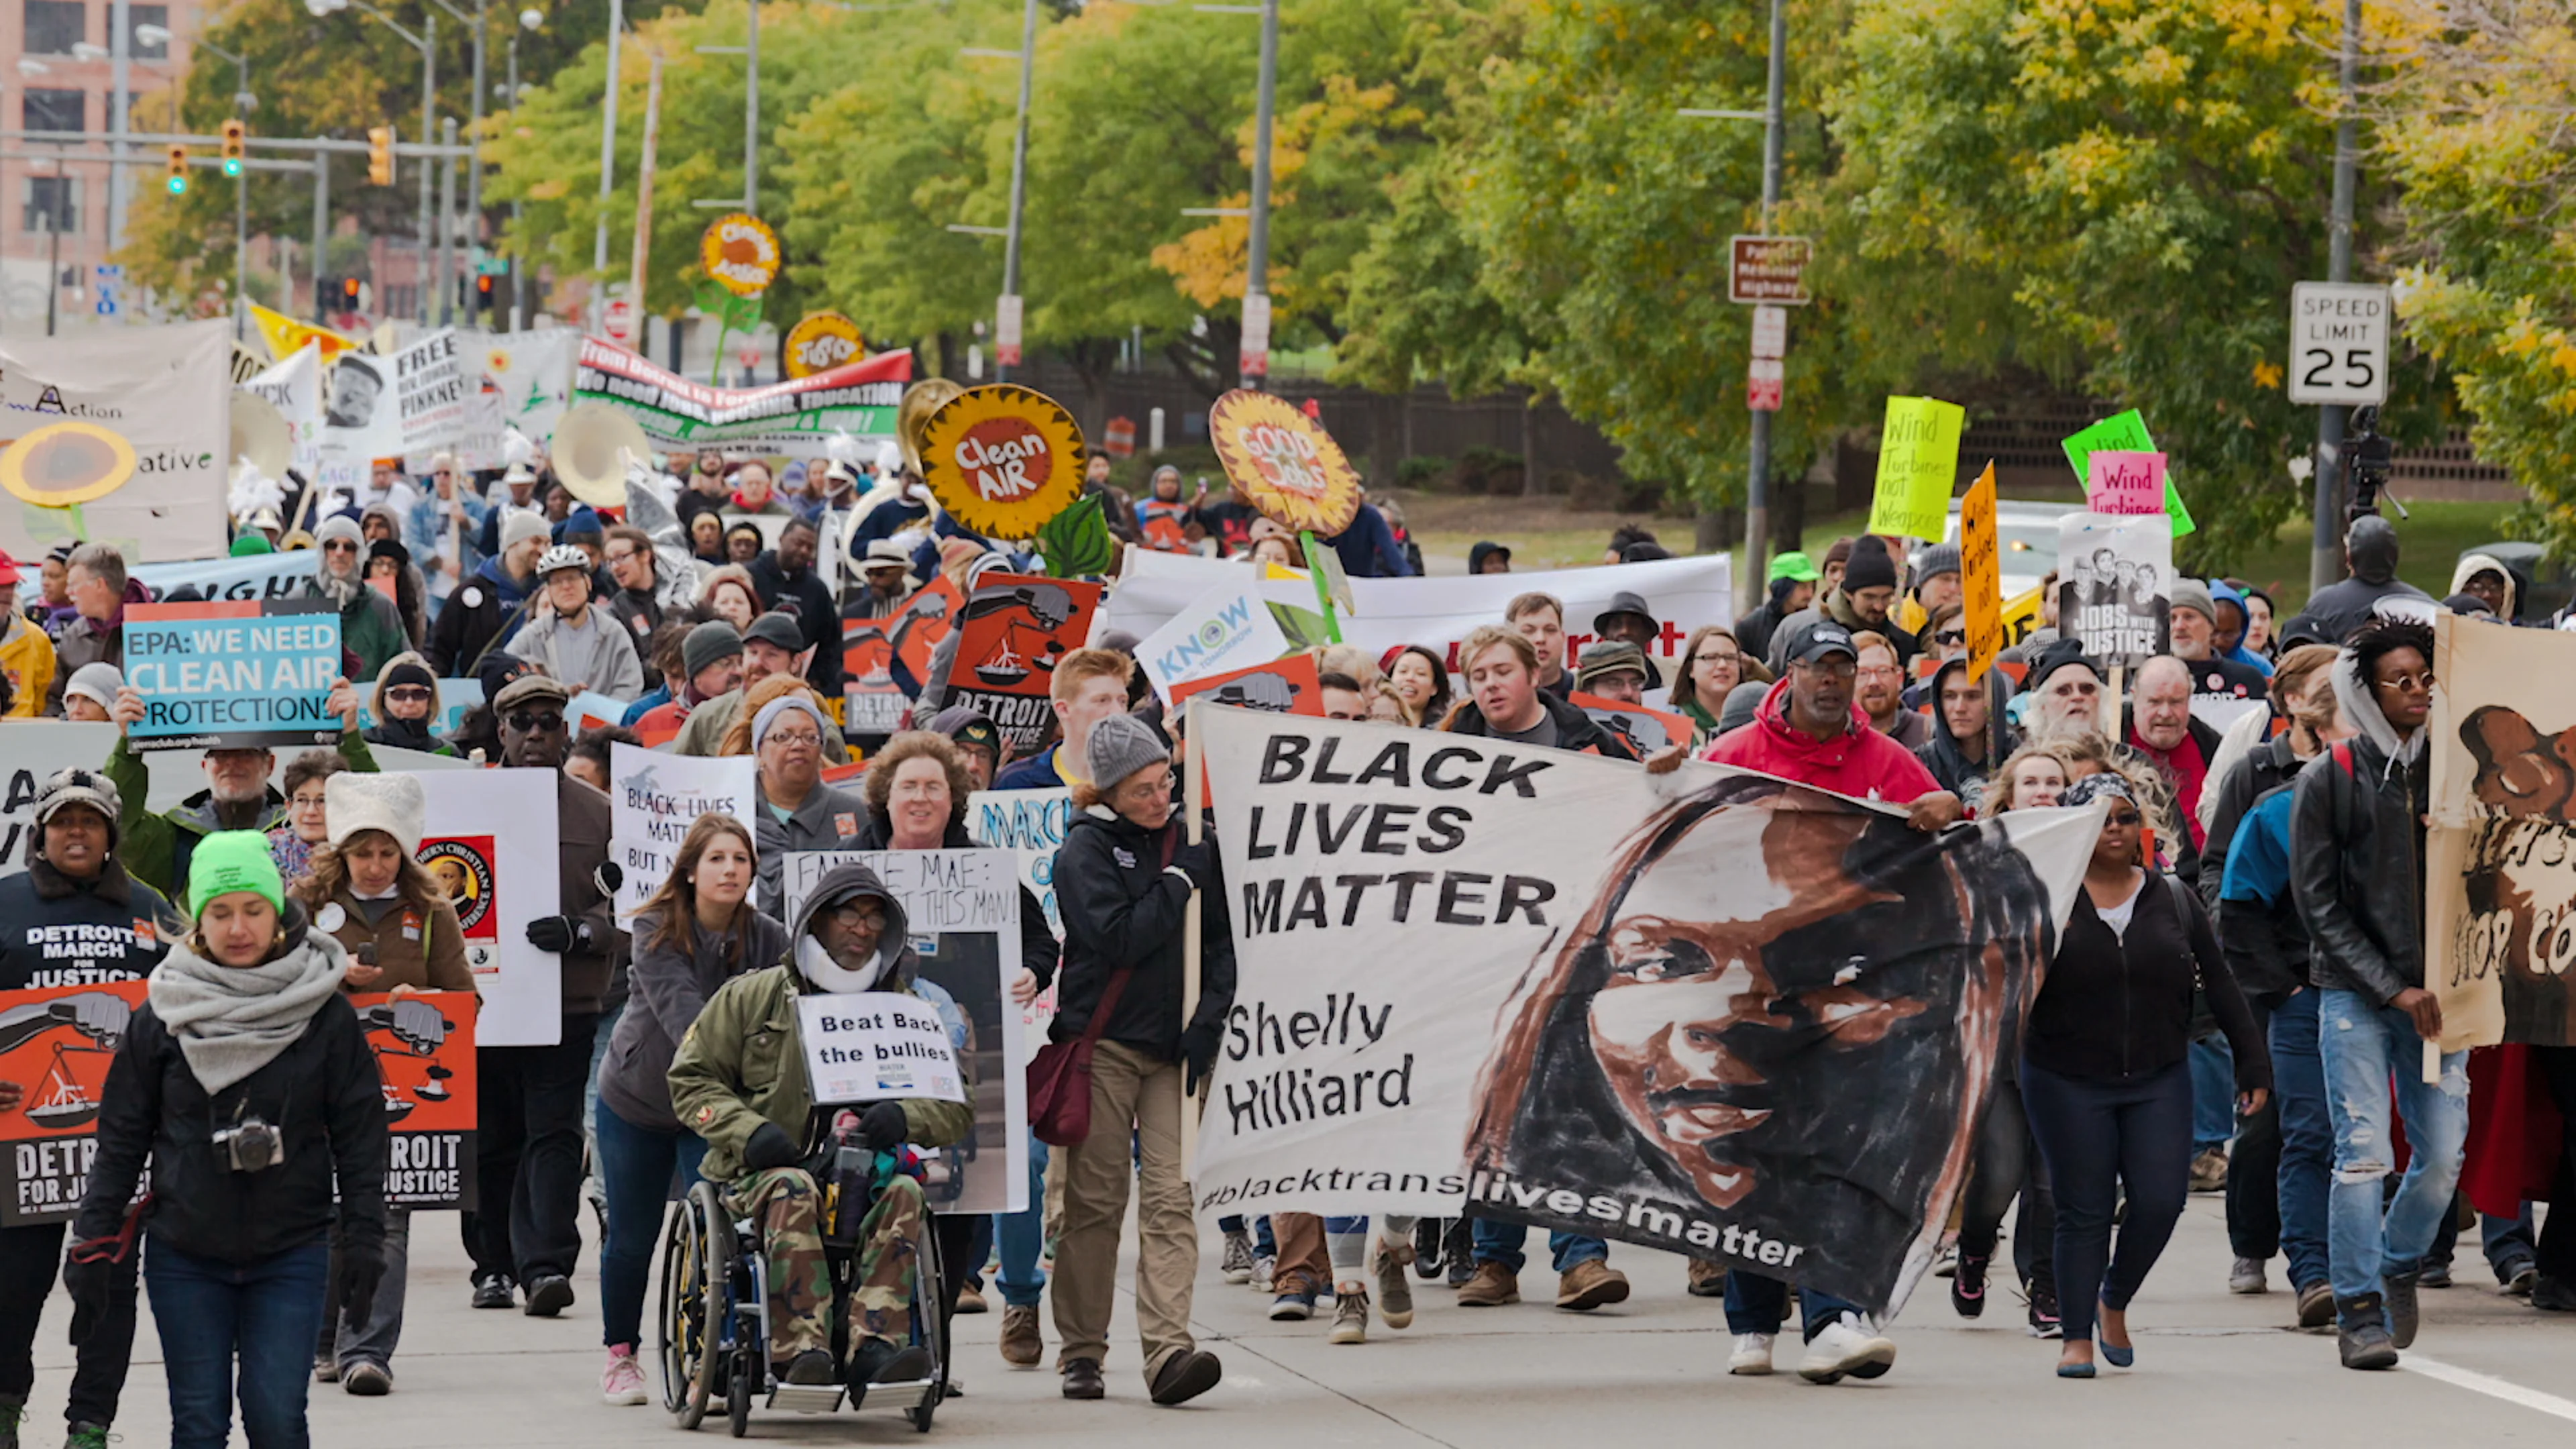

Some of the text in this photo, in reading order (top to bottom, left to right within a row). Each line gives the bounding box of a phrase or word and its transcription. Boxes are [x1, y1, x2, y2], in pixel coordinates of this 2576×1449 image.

[2304, 298, 2380, 317] SPEED
[2310, 324, 2369, 340] LIMIT
[396, 336, 458, 377] FREE
[2304, 347, 2374, 388] 25
[36, 384, 123, 419] Action
[400, 373, 464, 419] PINKNEY
[800, 382, 903, 411] EDUCATION
[1238, 425, 1317, 460] GOOD
[1888, 410, 1939, 443] Wind
[955, 434, 1046, 470] Clean
[1883, 445, 1949, 477] Turbines
[977, 462, 1036, 502] AIR
[1881, 476, 1908, 497] not
[2102, 462, 2153, 490] Wind
[1878, 500, 1942, 535] Weapons
[2074, 604, 2156, 631] JOBS WITH
[128, 625, 336, 655] EPA: WE NEED
[1156, 594, 1250, 681] KNOW
[1200, 625, 1253, 669] TOMORROW
[2081, 629, 2157, 657] JUSTICE
[129, 656, 338, 696] CLEAN AIR
[1258, 734, 1554, 798] BLACK
[628, 788, 735, 818] BLACK LIVES
[647, 820, 689, 843] MATT
[1247, 802, 1473, 861] LIVES
[628, 847, 658, 871] BUT
[921, 853, 990, 889] MAE:
[920, 889, 966, 927] THIS
[972, 890, 1018, 925] MAN!
[1242, 870, 1557, 939] MATTER
[26, 924, 136, 945] DETROIT
[43, 941, 125, 959] MARCH
[73, 959, 95, 968] FOR
[820, 1013, 943, 1034] Beat Back
[1226, 991, 1393, 1062] Shelly
[820, 1042, 950, 1064] the bullies
[1225, 1053, 1414, 1136] Hilliard
[18, 1179, 60, 1205] FOR
